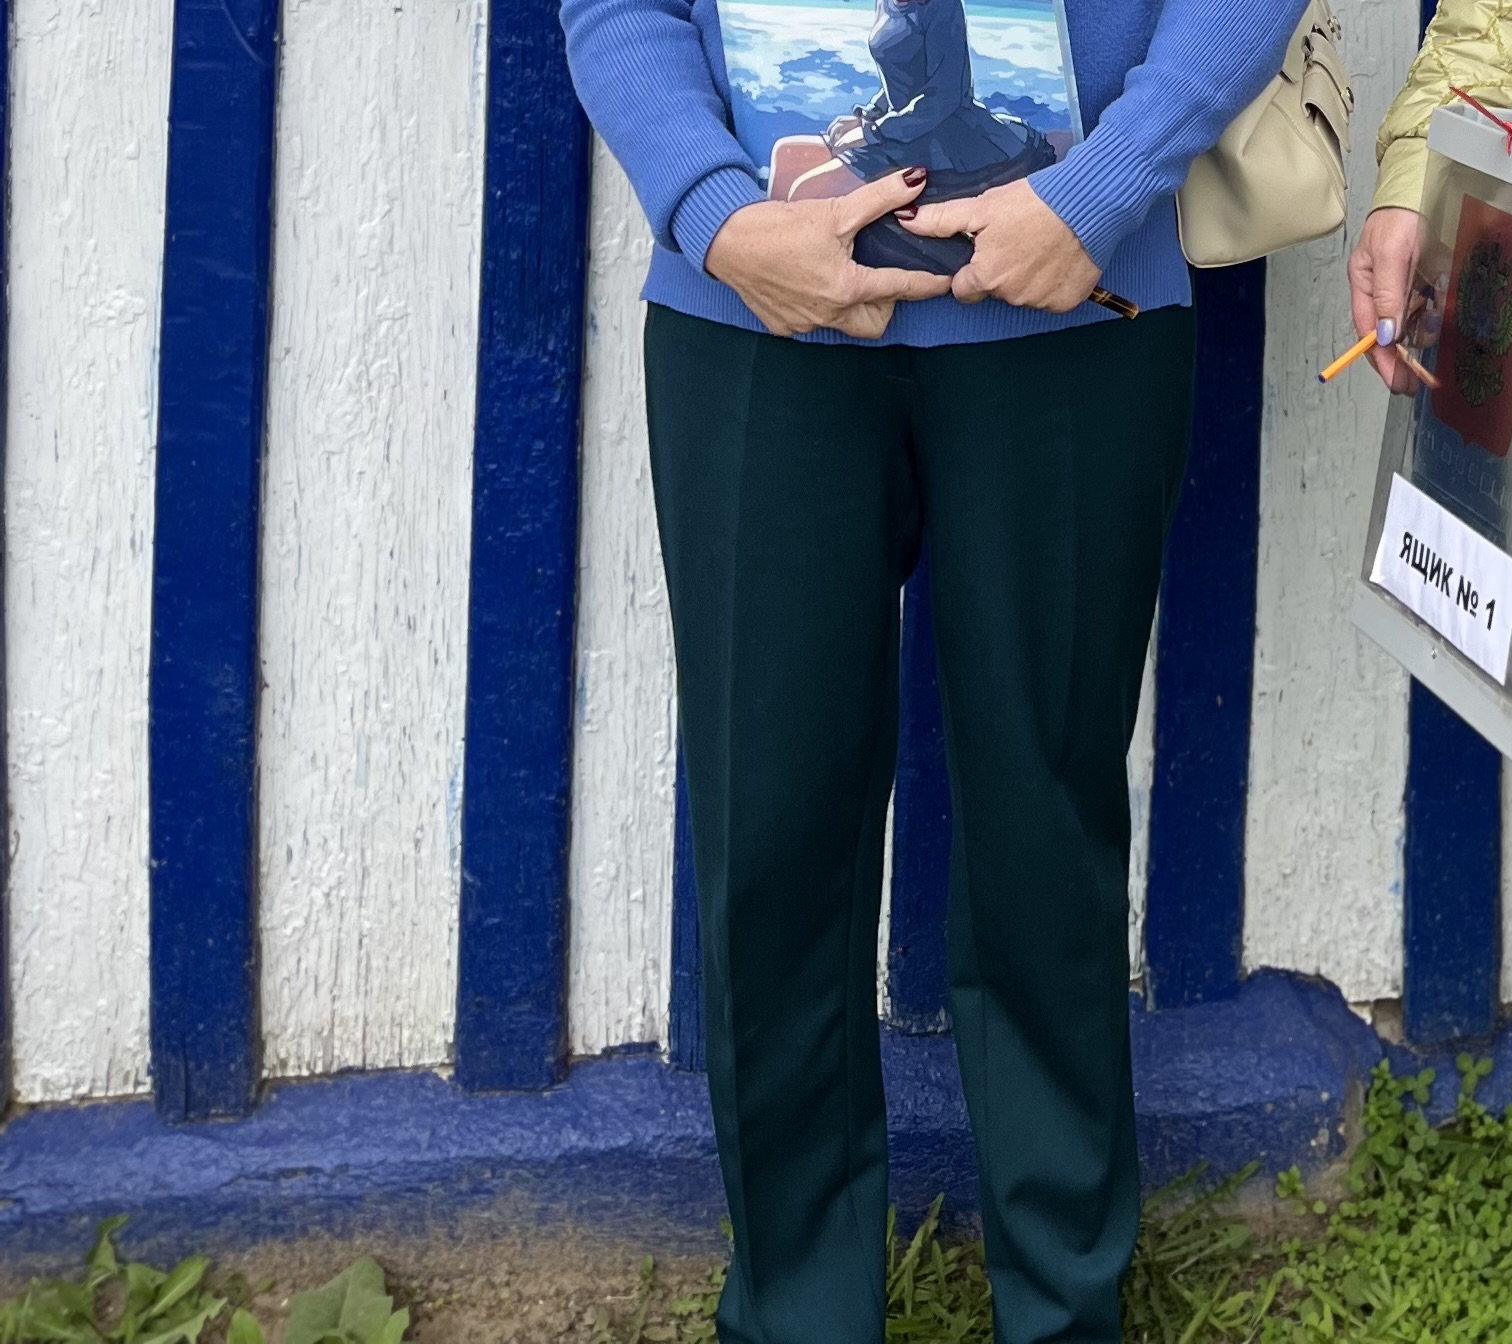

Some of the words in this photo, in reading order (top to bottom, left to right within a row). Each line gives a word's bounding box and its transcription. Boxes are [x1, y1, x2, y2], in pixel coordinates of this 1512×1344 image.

[1399, 531, 1453, 598] ЯЩИК
[1456, 575, 1479, 618] №
[1486, 599, 1496, 631] 1
